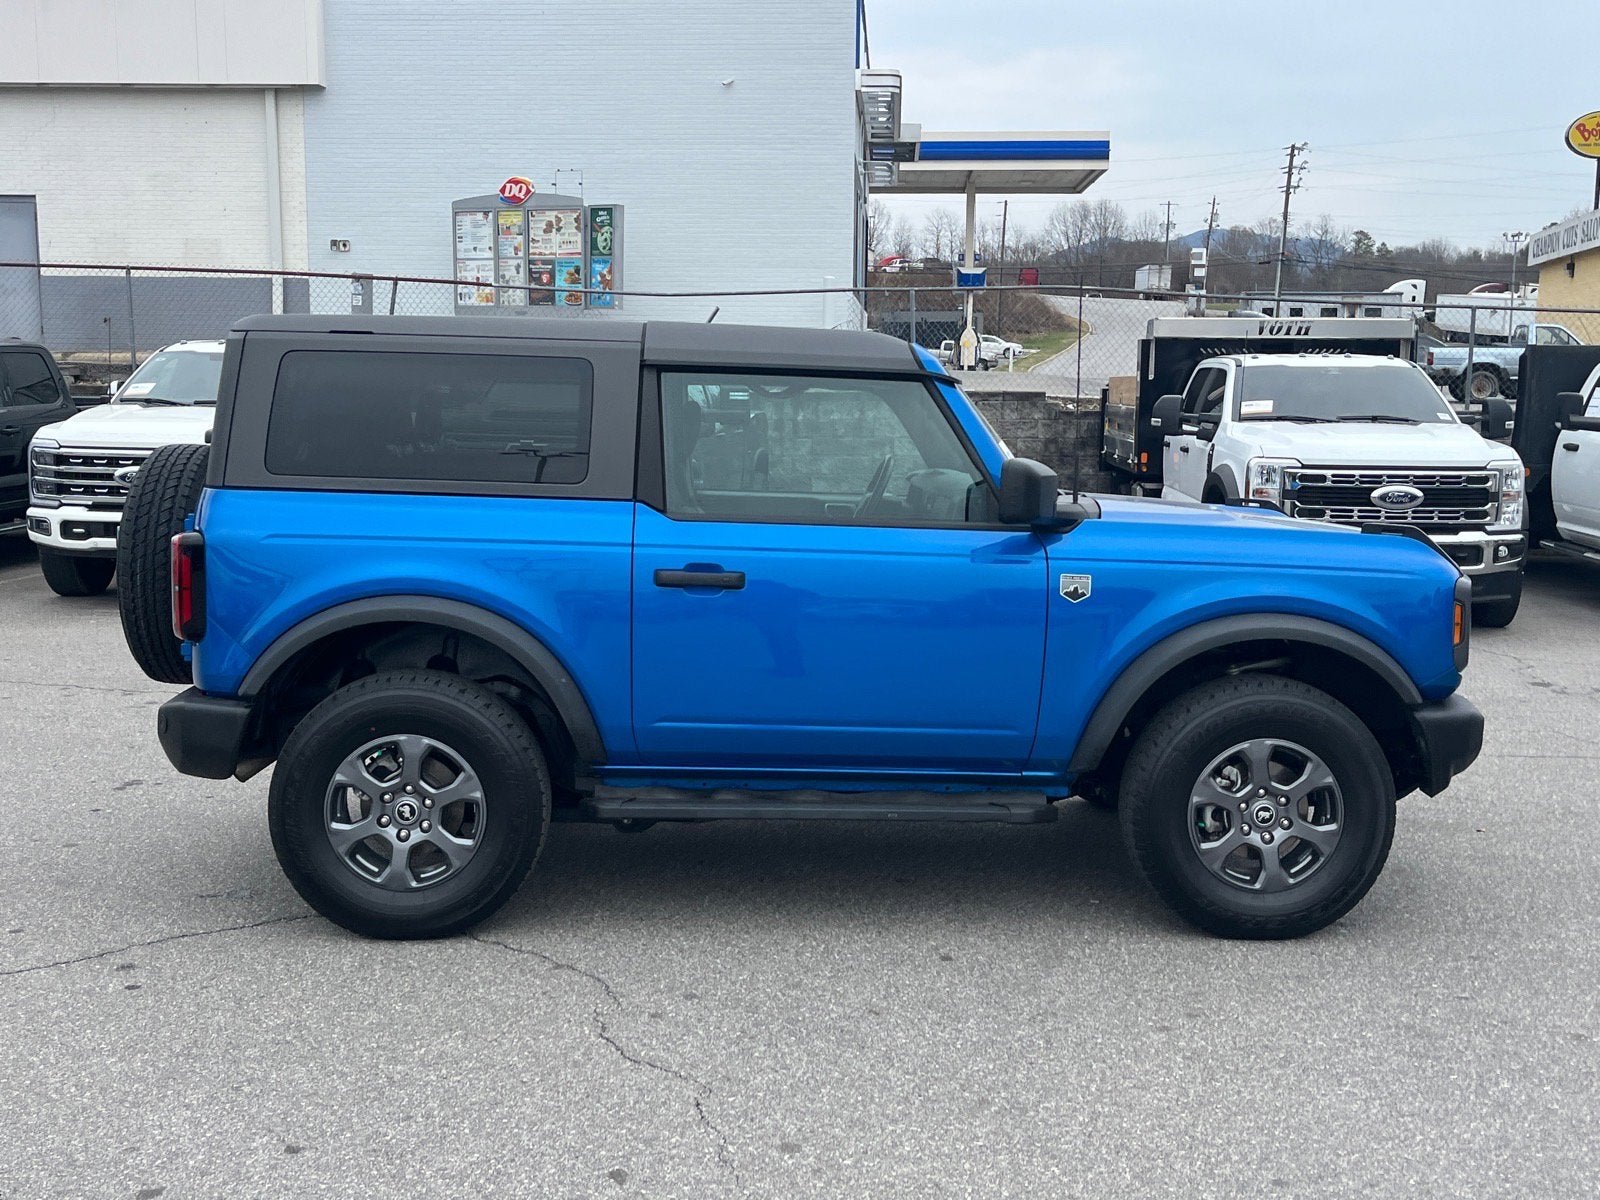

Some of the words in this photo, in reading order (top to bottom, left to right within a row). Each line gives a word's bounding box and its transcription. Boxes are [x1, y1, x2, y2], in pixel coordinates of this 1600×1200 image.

[504, 183, 527, 199] DQ
[1533, 231, 1560, 258] CHAMPION
[1562, 224, 1578, 250] CUTS
[1258, 320, 1313, 336] VOTH
[1385, 491, 1412, 503] Ford
